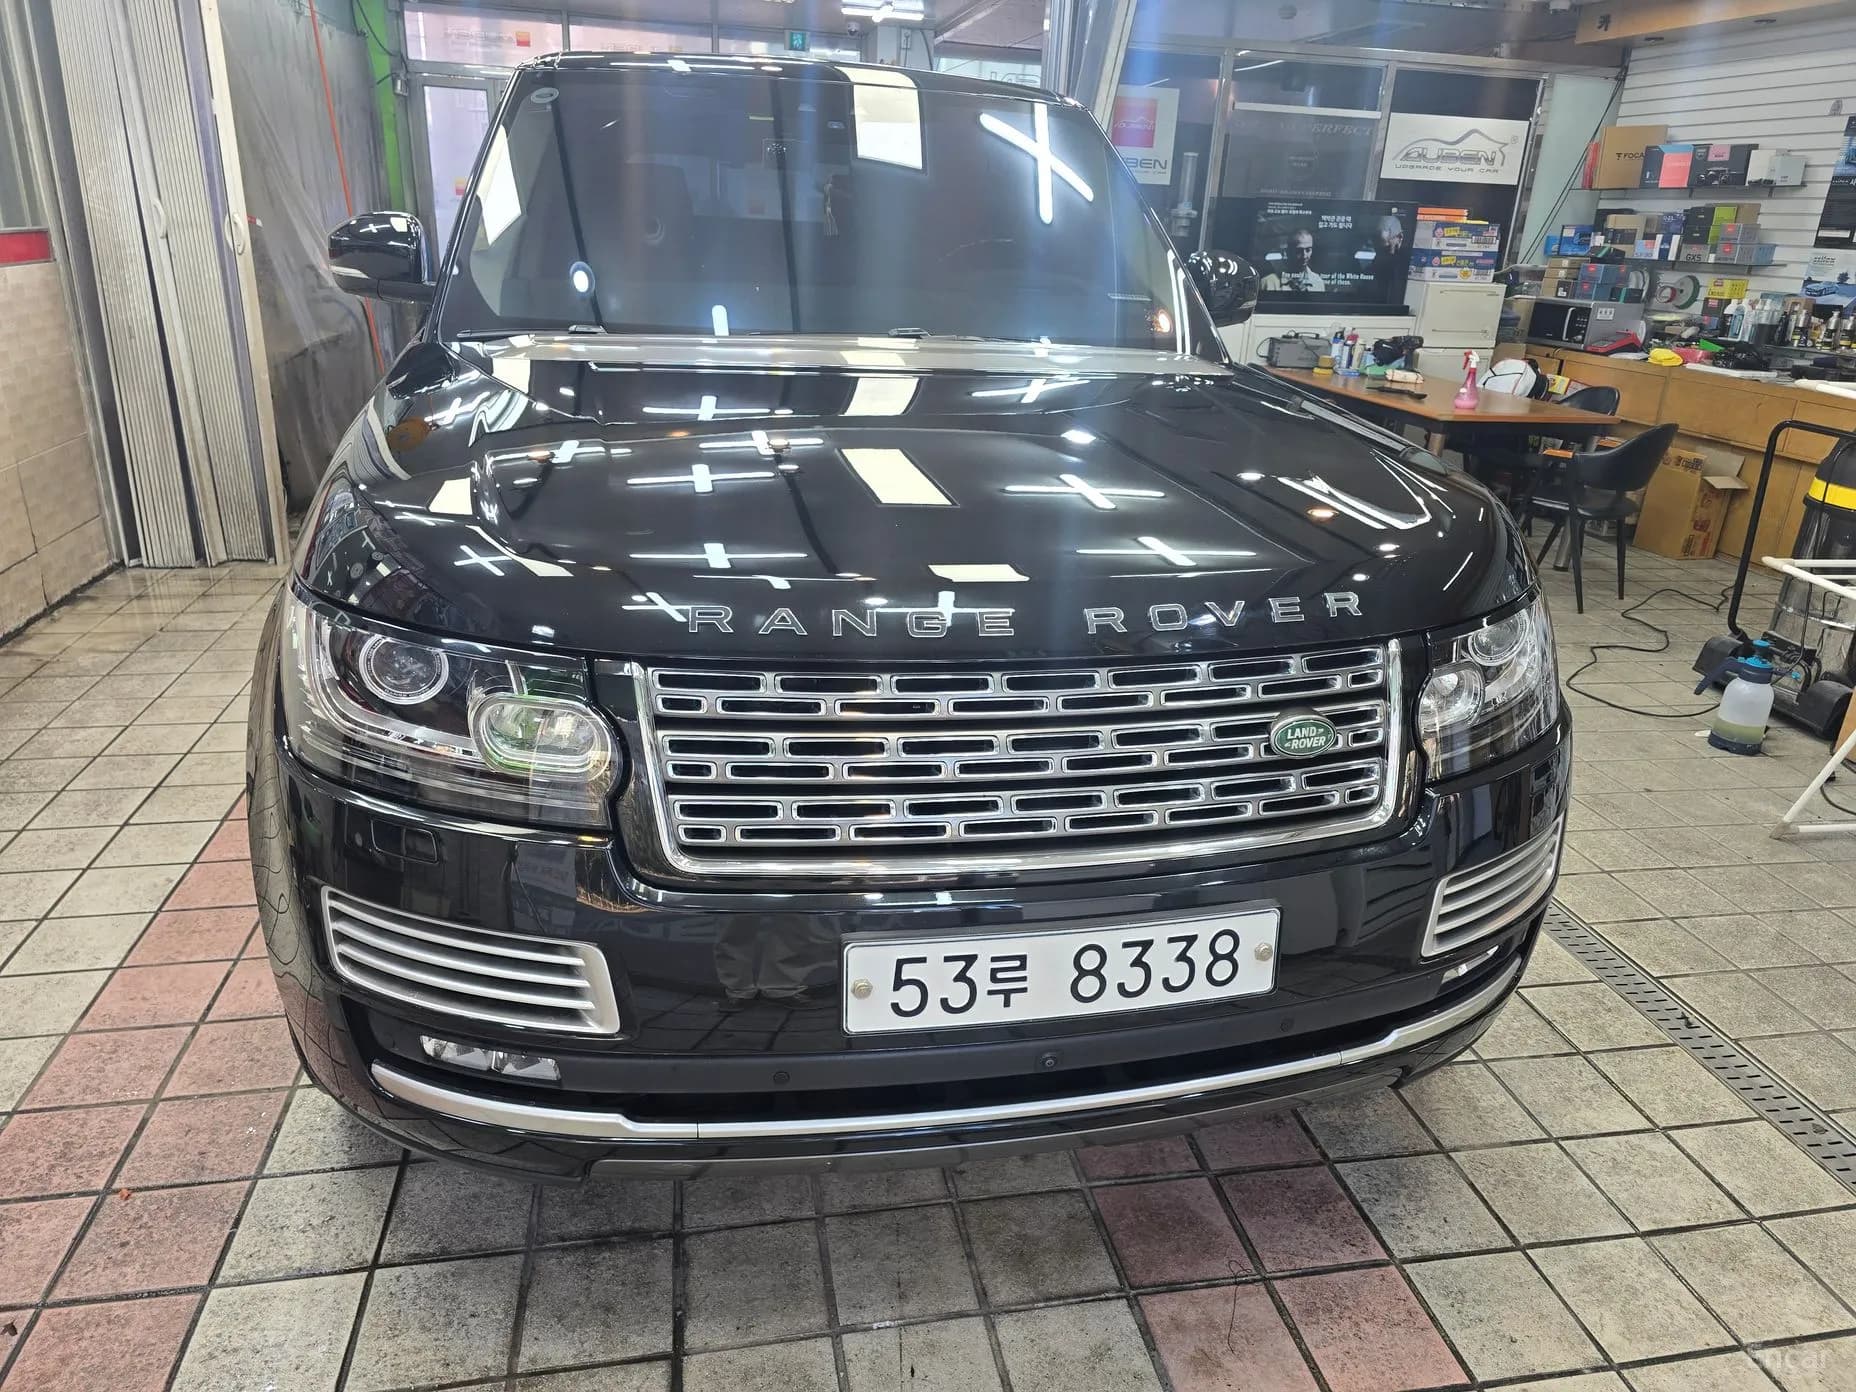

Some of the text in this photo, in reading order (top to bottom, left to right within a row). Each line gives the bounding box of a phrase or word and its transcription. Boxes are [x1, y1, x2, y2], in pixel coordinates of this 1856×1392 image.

[1400, 146, 1497, 166] AUBEN
[688, 592, 1363, 638] RANGE ROVER
[1287, 726, 1317, 740] LAND
[1290, 735, 1327, 750] ROVER
[889, 928, 1241, 1018] 53루 8338
